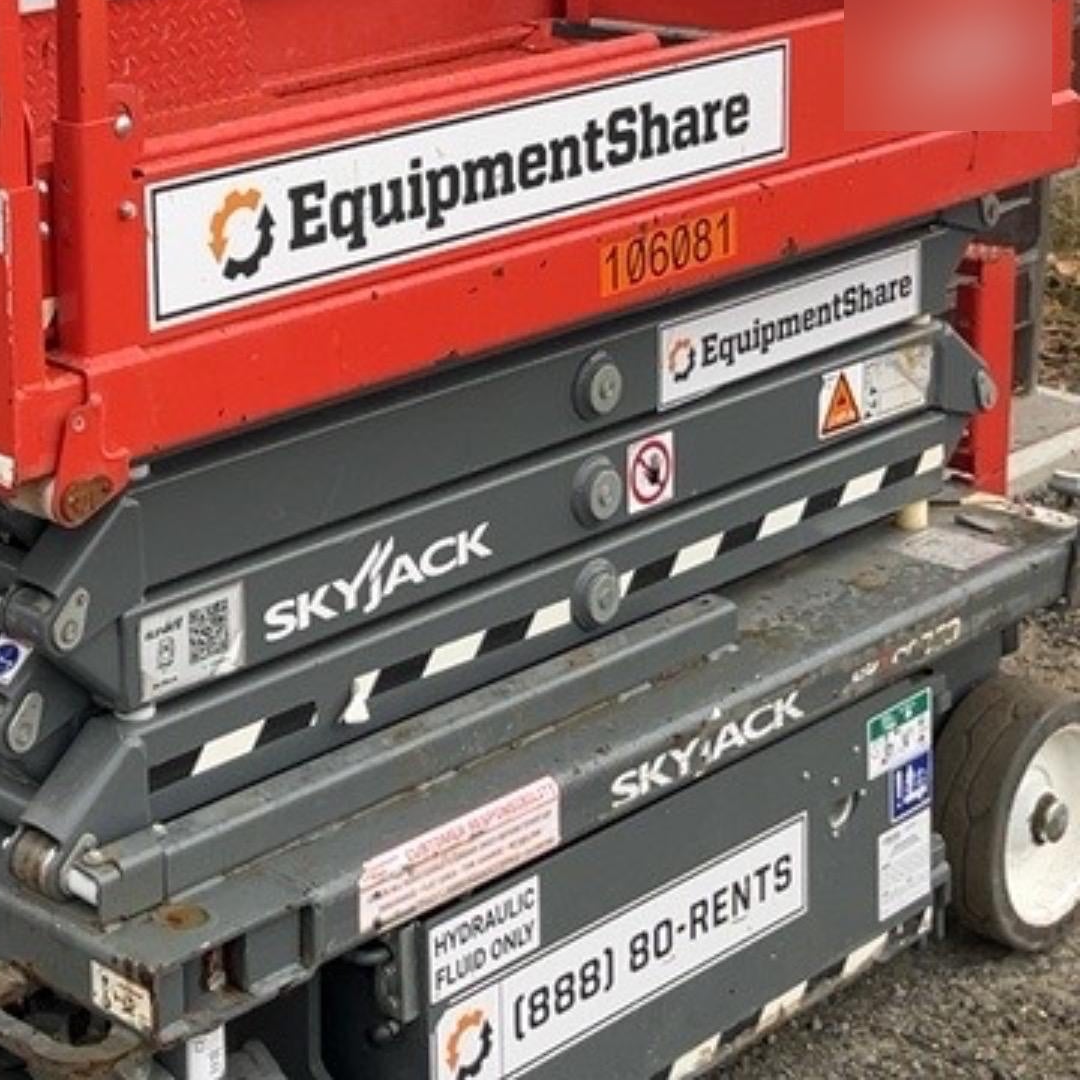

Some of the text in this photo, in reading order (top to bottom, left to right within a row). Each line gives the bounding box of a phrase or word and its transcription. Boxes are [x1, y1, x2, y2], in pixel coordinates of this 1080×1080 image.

[287, 92, 750, 252] EquipmentShare
[605, 212, 732, 292] 106081
[700, 273, 913, 368] EquipmentShare
[263, 521, 493, 642] SKYJACK
[434, 887, 536, 958] HYDRAULIC
[434, 921, 536, 992] FLUID ONLY
[514, 946, 615, 1041] (888)
[628, 853, 793, 974] 80-RENTS
